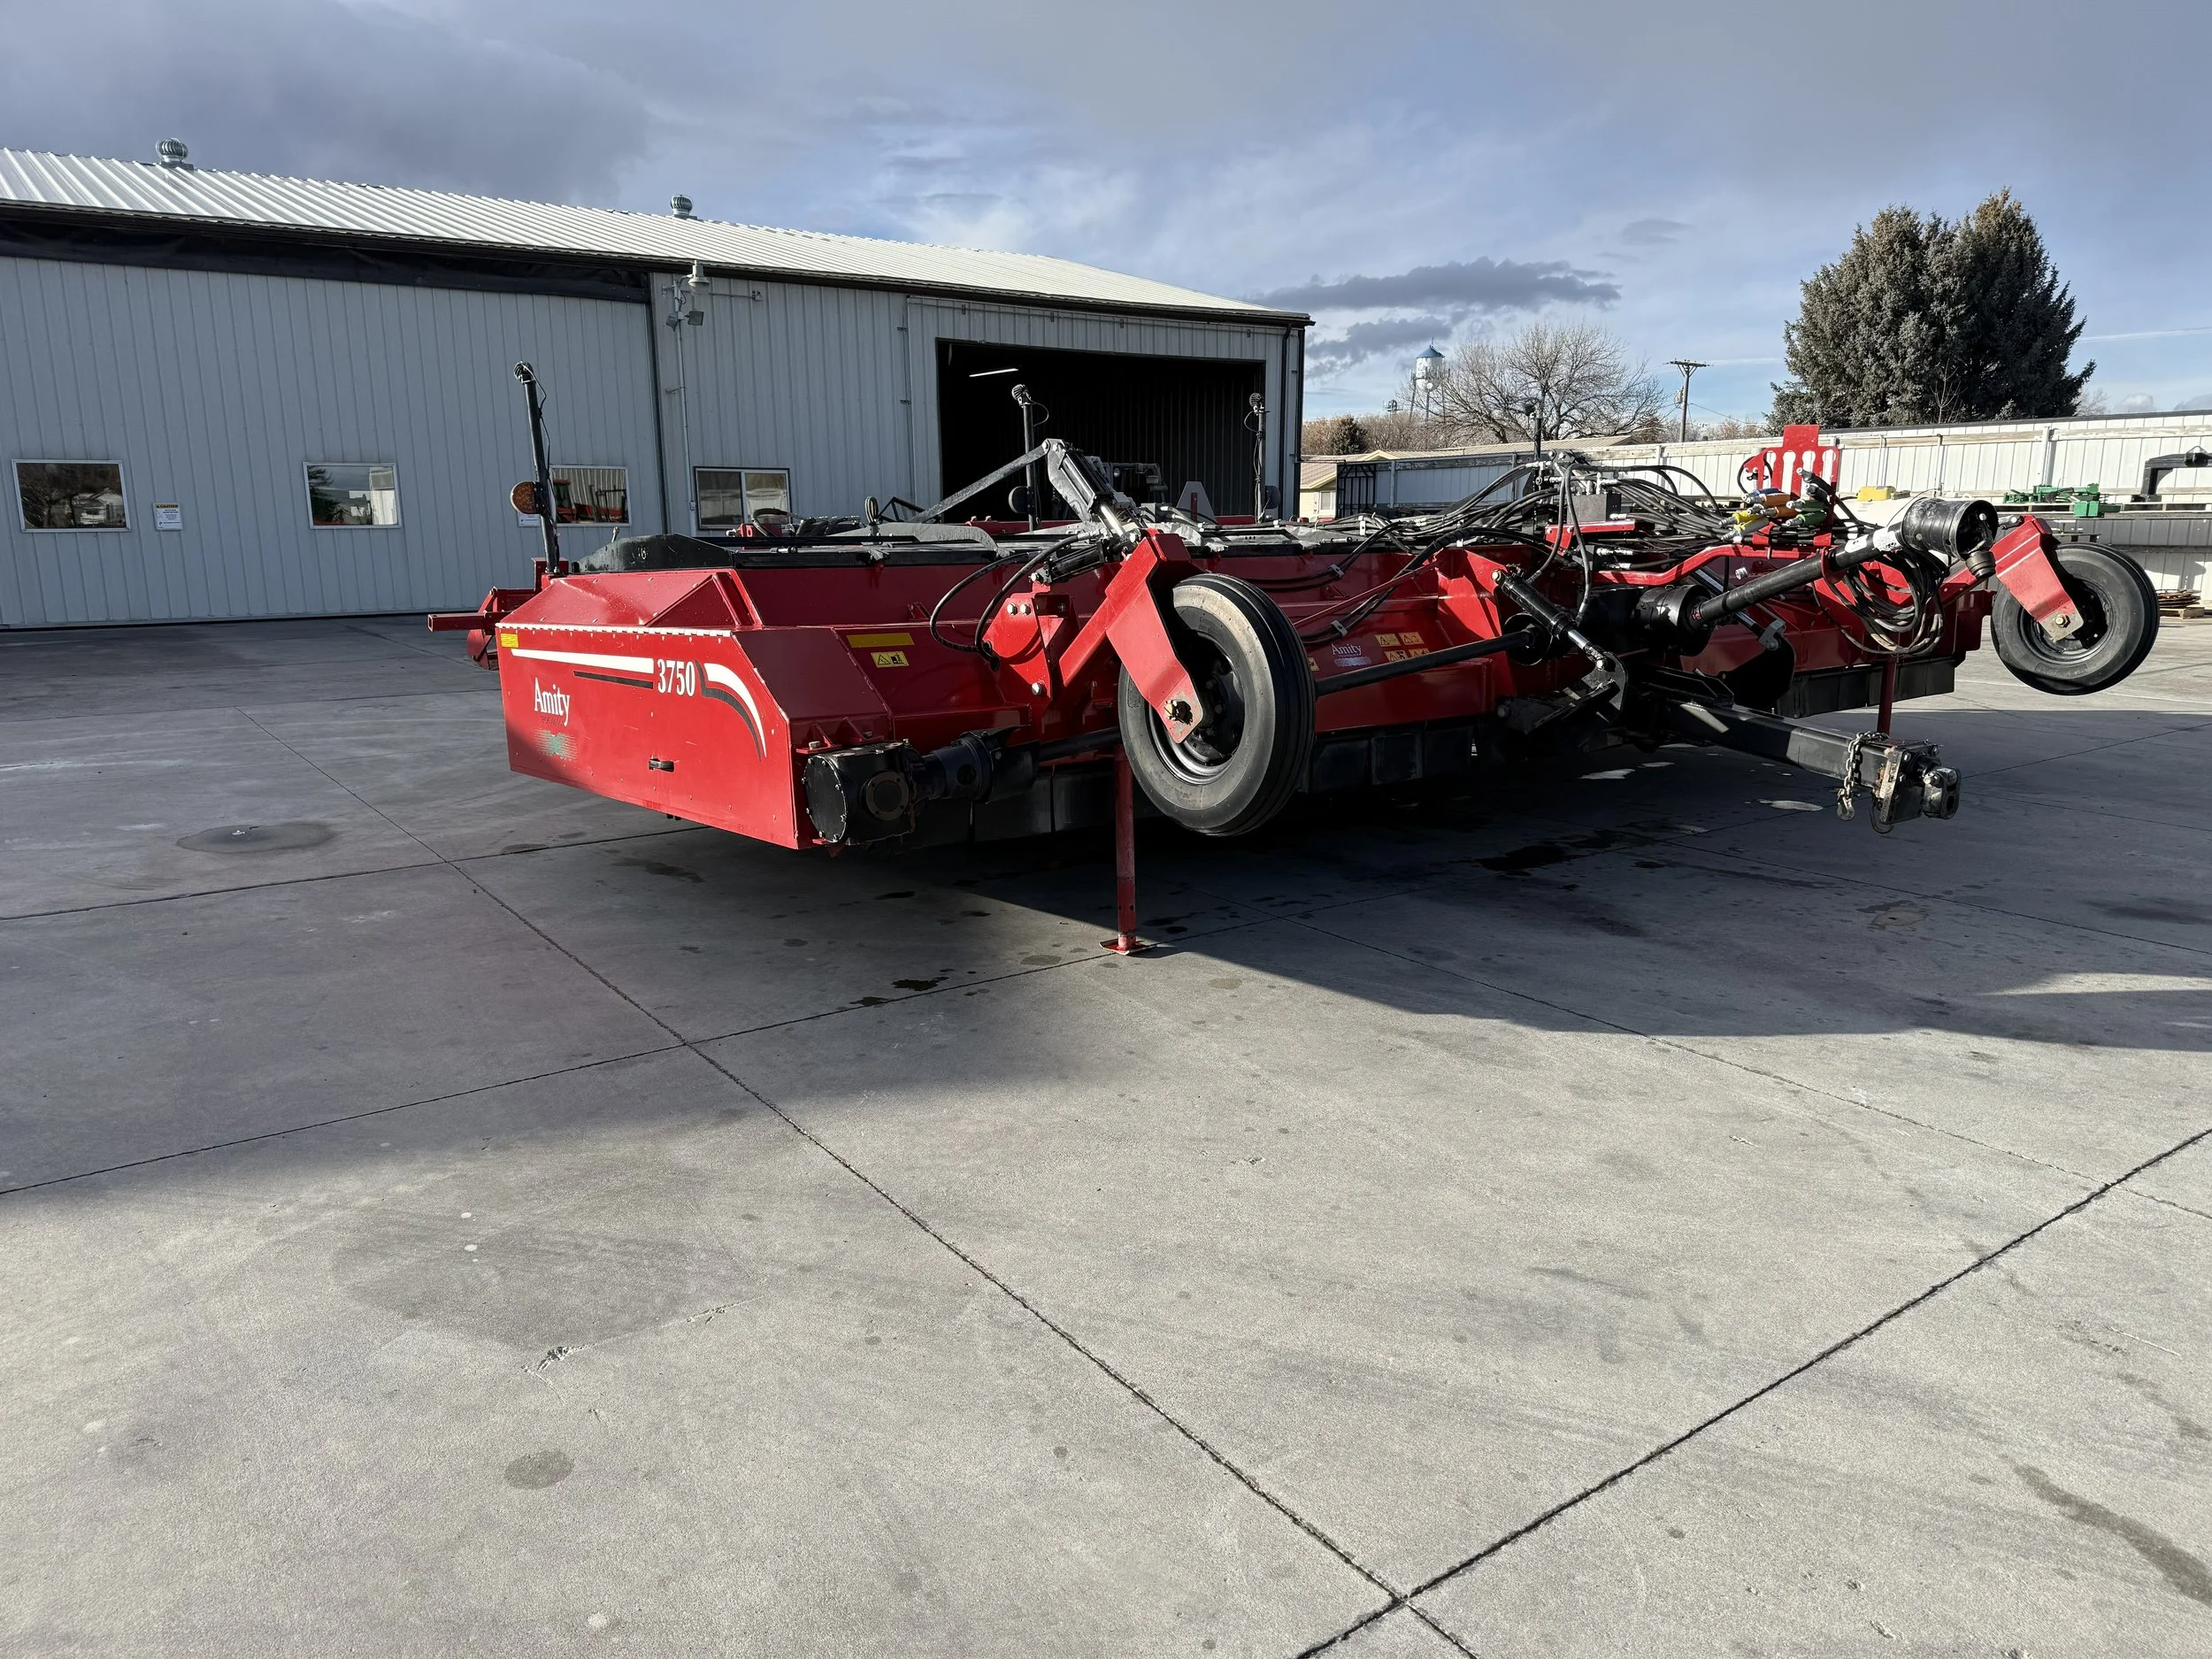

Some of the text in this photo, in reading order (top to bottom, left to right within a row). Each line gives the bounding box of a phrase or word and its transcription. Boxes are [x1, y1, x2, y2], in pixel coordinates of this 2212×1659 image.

[1332, 643, 1362, 656] Amity
[657, 658, 695, 697] 3750
[534, 677, 571, 726] Amity
